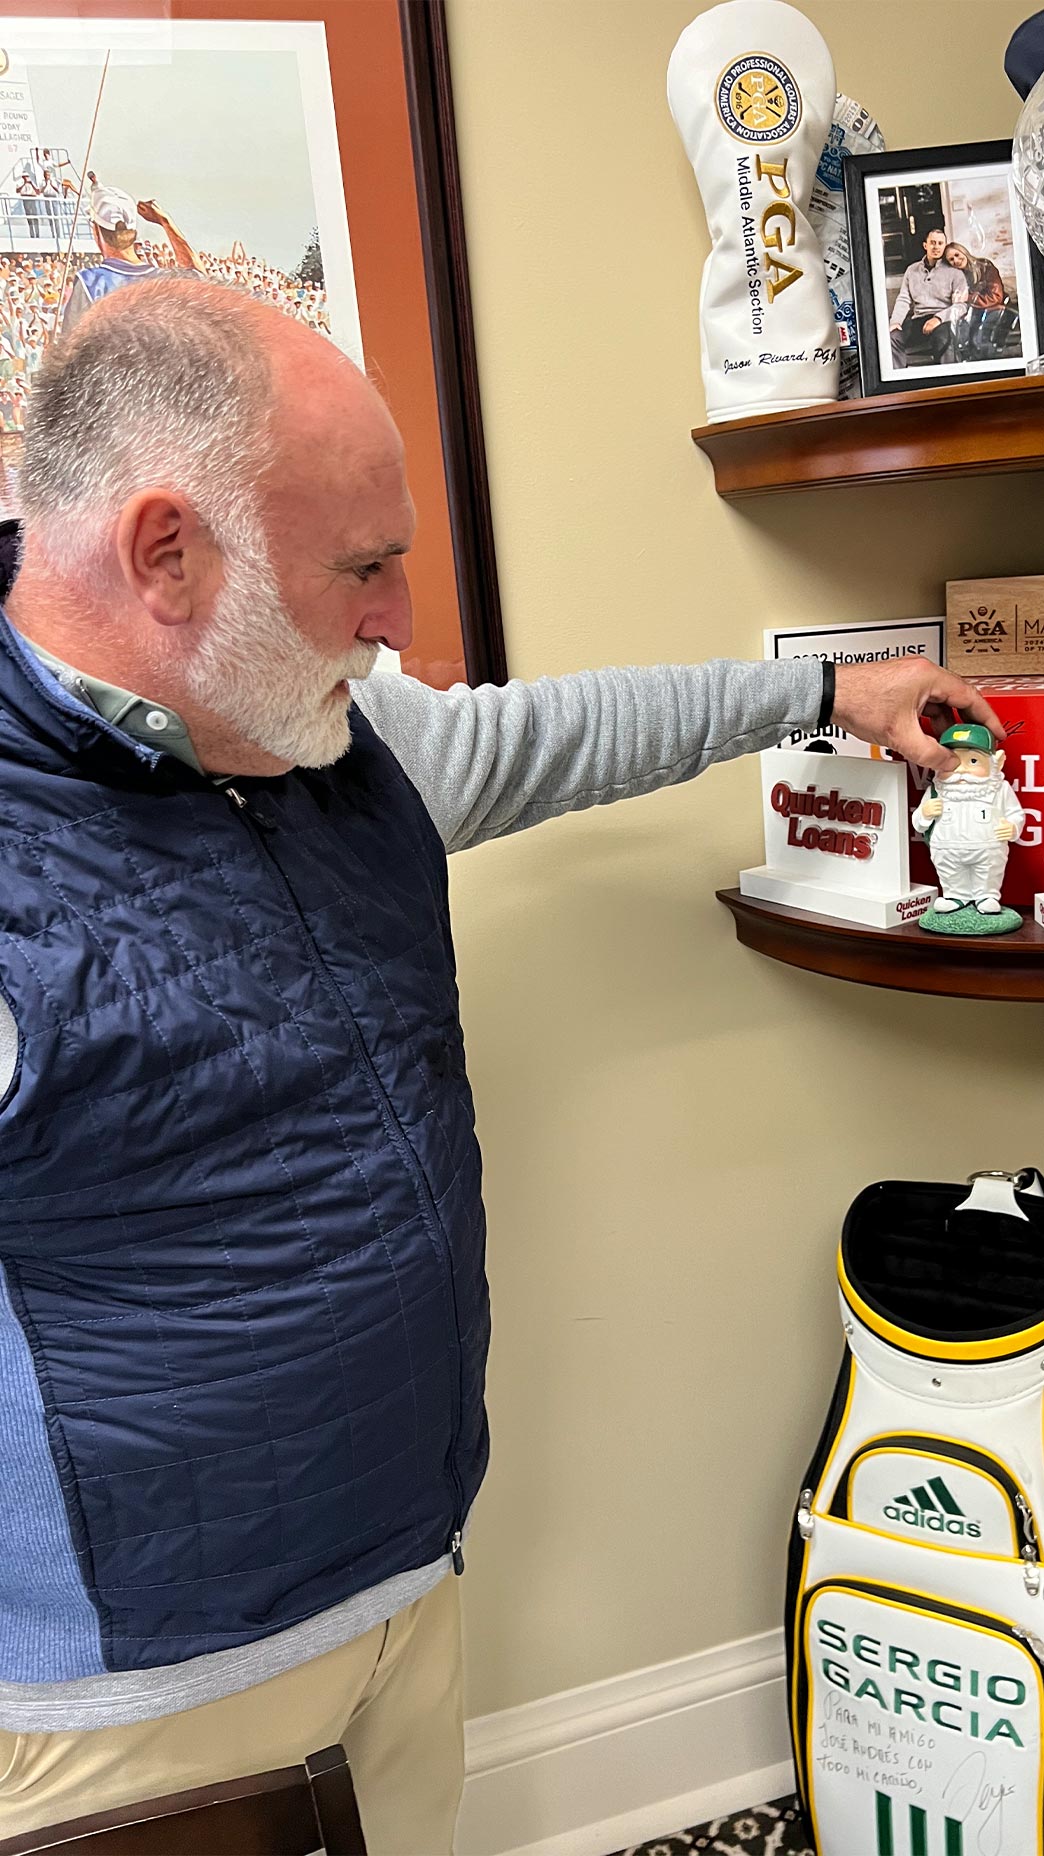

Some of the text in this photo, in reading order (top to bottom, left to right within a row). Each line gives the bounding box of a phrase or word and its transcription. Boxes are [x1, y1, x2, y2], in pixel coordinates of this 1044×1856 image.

[723, 76, 733, 88] OF
[731, 59, 786, 84] PROFESSIONAL
[720, 87, 738, 129] AMERICA
[735, 92, 743, 110] 1916
[751, 74, 768, 126] PGA
[736, 121, 791, 140] ASSOCIATION
[756, 153, 804, 304] PGA
[737, 156, 765, 335] Middle Atlantic Section
[724, 358, 753, 375] Jason
[813, 347, 838, 365] PGA
[958, 621, 1008, 637] PGA
[1024, 619, 1044, 634] M
[771, 782, 885, 828] Quicken
[788, 817, 873, 860] Loans
[896, 895, 931, 912] Quicken
[901, 906, 928, 920] Loans
[883, 1504, 982, 1538] adidas
[817, 1619, 1026, 1706] SERGIO
[822, 1658, 1025, 1748] GARCIA
